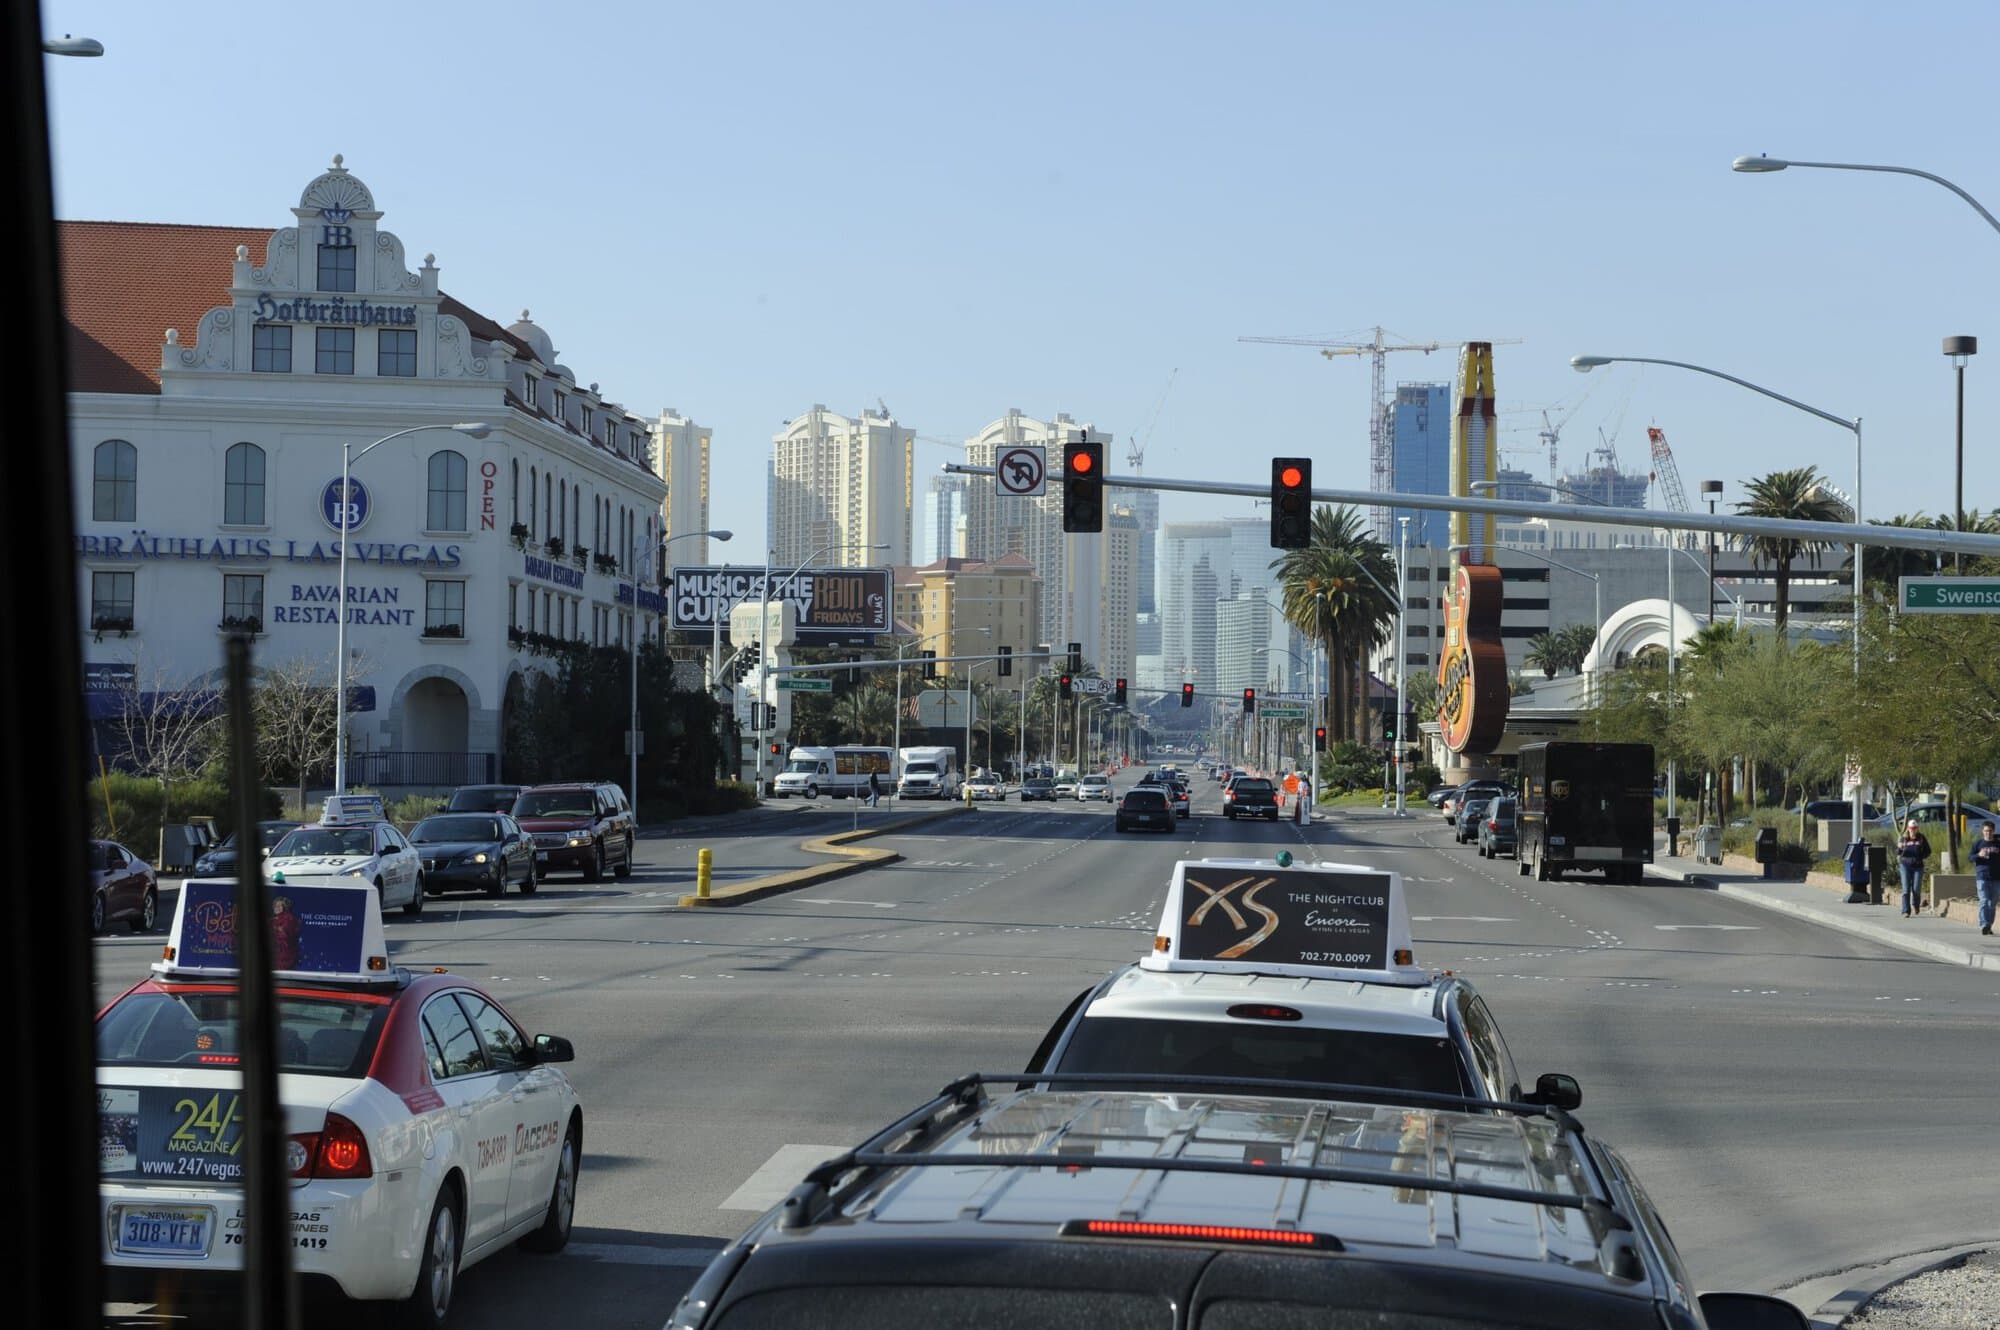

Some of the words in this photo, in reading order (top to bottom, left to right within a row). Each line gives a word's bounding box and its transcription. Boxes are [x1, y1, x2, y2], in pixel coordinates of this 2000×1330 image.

[322, 225, 353, 249] HB
[252, 291, 417, 329] Hofbräuhaus
[480, 461, 497, 531] OPEN
[332, 502, 360, 524] HB
[287, 540, 343, 563] LAS
[350, 543, 462, 568] VEGAS
[291, 585, 399, 604] BAVARIAN
[679, 575, 744, 597] MUSIC
[750, 575, 765, 597] IS
[771, 576, 813, 598] THE
[1909, 587, 1917, 598] S
[814, 611, 864, 624] FRIDAYS
[874, 595, 884, 624] PALMS
[273, 857, 346, 867] 6248
[1287, 893, 1311, 903] THE
[1315, 894, 1384, 906] NIGHTCLUB
[1186, 876, 1279, 958] XS
[1304, 910, 1370, 927] Encore
[1300, 951, 1371, 963] 702.770.0097
[168, 1140, 230, 1153] MAGAZINE
[148, 1211, 186, 1221] NEVADA
